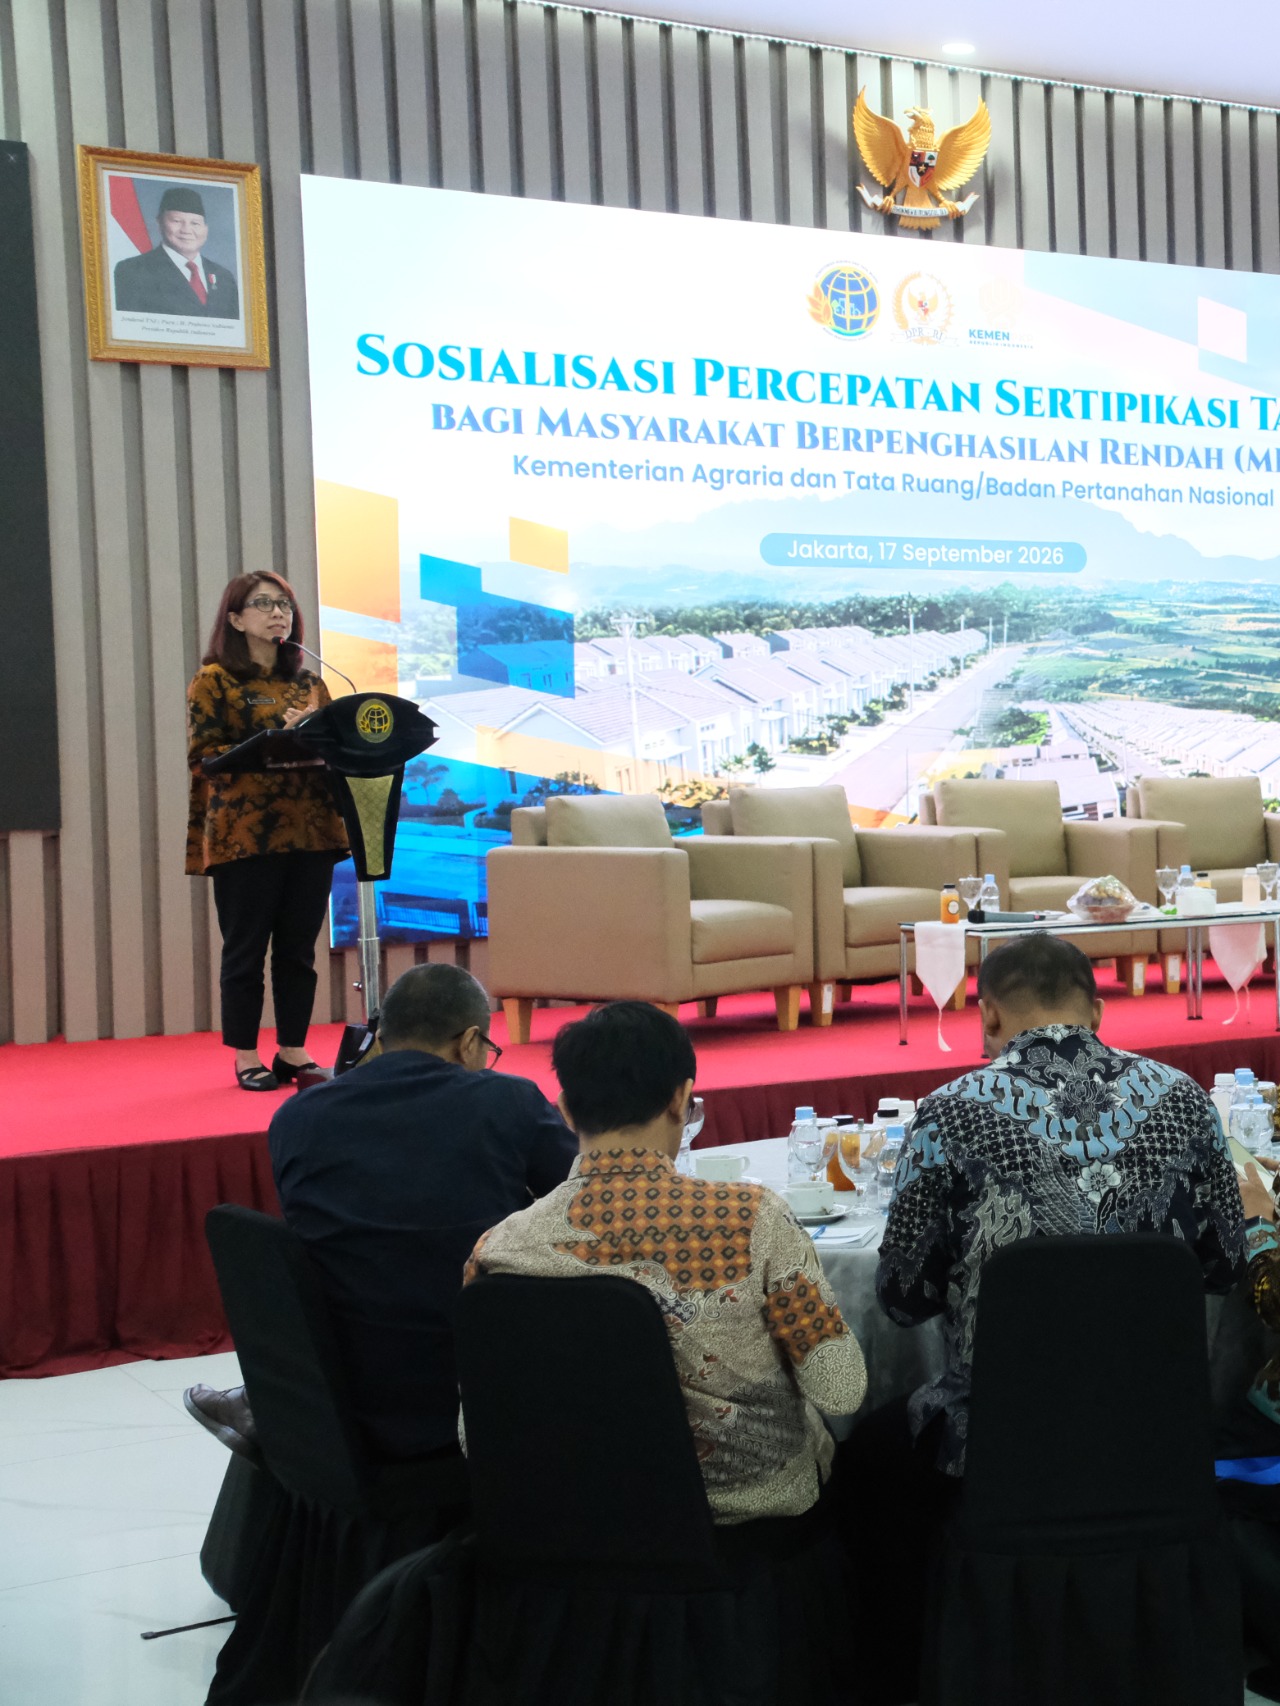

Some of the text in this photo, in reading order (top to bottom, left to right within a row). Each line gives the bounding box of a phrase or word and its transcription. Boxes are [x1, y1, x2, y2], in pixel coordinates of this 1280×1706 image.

[356, 334, 675, 395] SOSIALISASI
[693, 358, 980, 413] PERCEPATAN
[995, 379, 1239, 430] SERTIPIKASI
[432, 403, 523, 435] BAGI
[536, 407, 784, 448] MASYARAKAT
[797, 421, 1089, 464] BERPENGHASILAN
[1100, 438, 1223, 471] RENDAH
[513, 455, 1274, 507] Kementerian Agraria dan Tata Ruang/Badan Pertanahan Nasional
[787, 539, 1064, 567] Jakarta, 17 September 2026
